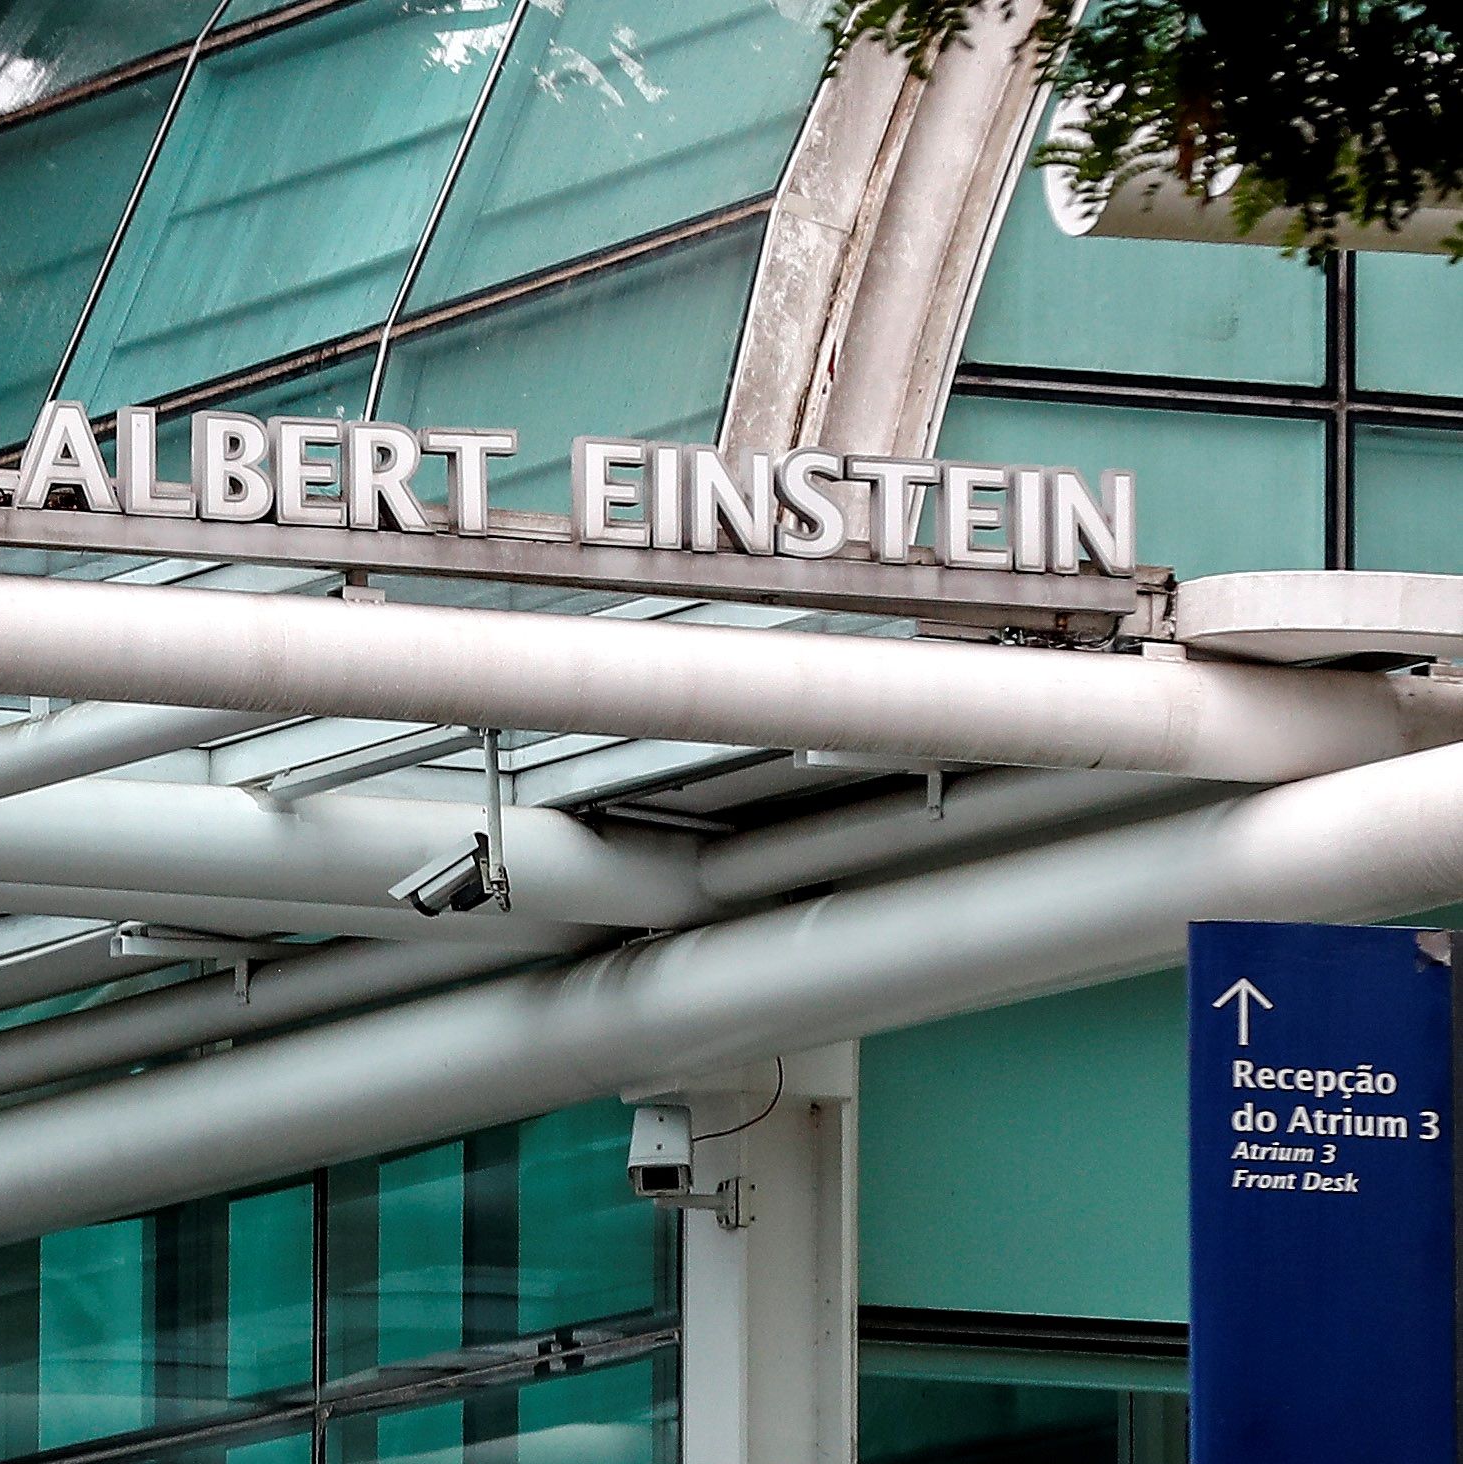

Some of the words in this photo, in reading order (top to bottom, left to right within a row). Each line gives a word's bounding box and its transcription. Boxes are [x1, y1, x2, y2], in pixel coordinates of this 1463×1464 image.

[13, 399, 517, 537] ALBERT
[573, 436, 1135, 577] EINSTEIN
[1232, 1059, 1398, 1099] Recepção
[1231, 1102, 1278, 1132] do
[1286, 1105, 1409, 1138] Atrium
[1419, 1111, 1440, 1140] 3
[1231, 1141, 1315, 1162] Atrium
[1320, 1144, 1337, 1164] 3
[1231, 1169, 1298, 1190] Front
[1302, 1172, 1360, 1193] Desk
